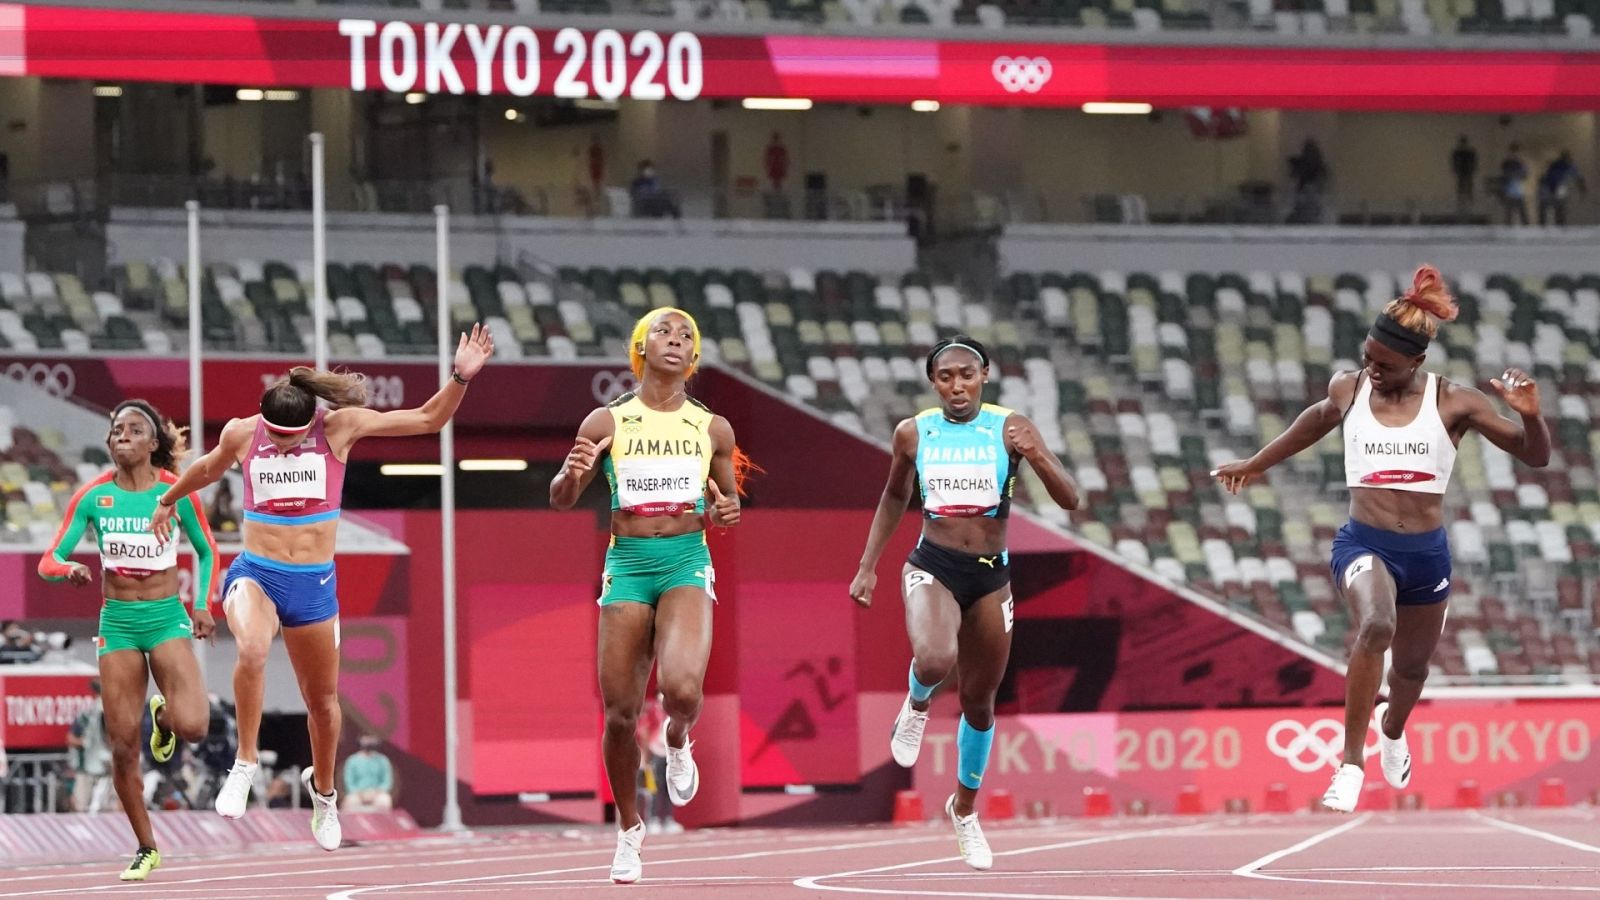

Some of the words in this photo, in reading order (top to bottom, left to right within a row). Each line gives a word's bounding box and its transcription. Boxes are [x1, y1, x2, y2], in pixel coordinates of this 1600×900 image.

[338, 19, 541, 97] TOKYO
[553, 27, 704, 101] 2020
[624, 439, 704, 458] JAMAICA
[922, 444, 998, 463] BAHAMAS
[1365, 442, 1430, 455] MASILINGI
[259, 469, 317, 485] PRANDINI
[626, 477, 690, 492] FRASER-PRYCE
[928, 478, 994, 491] STRACHAN
[109, 542, 164, 559] BAZOLO
[6, 695, 54, 726] TOKYO
[924, 733, 1098, 775] TKYO
[1115, 726, 1243, 771] 2020
[1411, 719, 1592, 765] TOKYO
